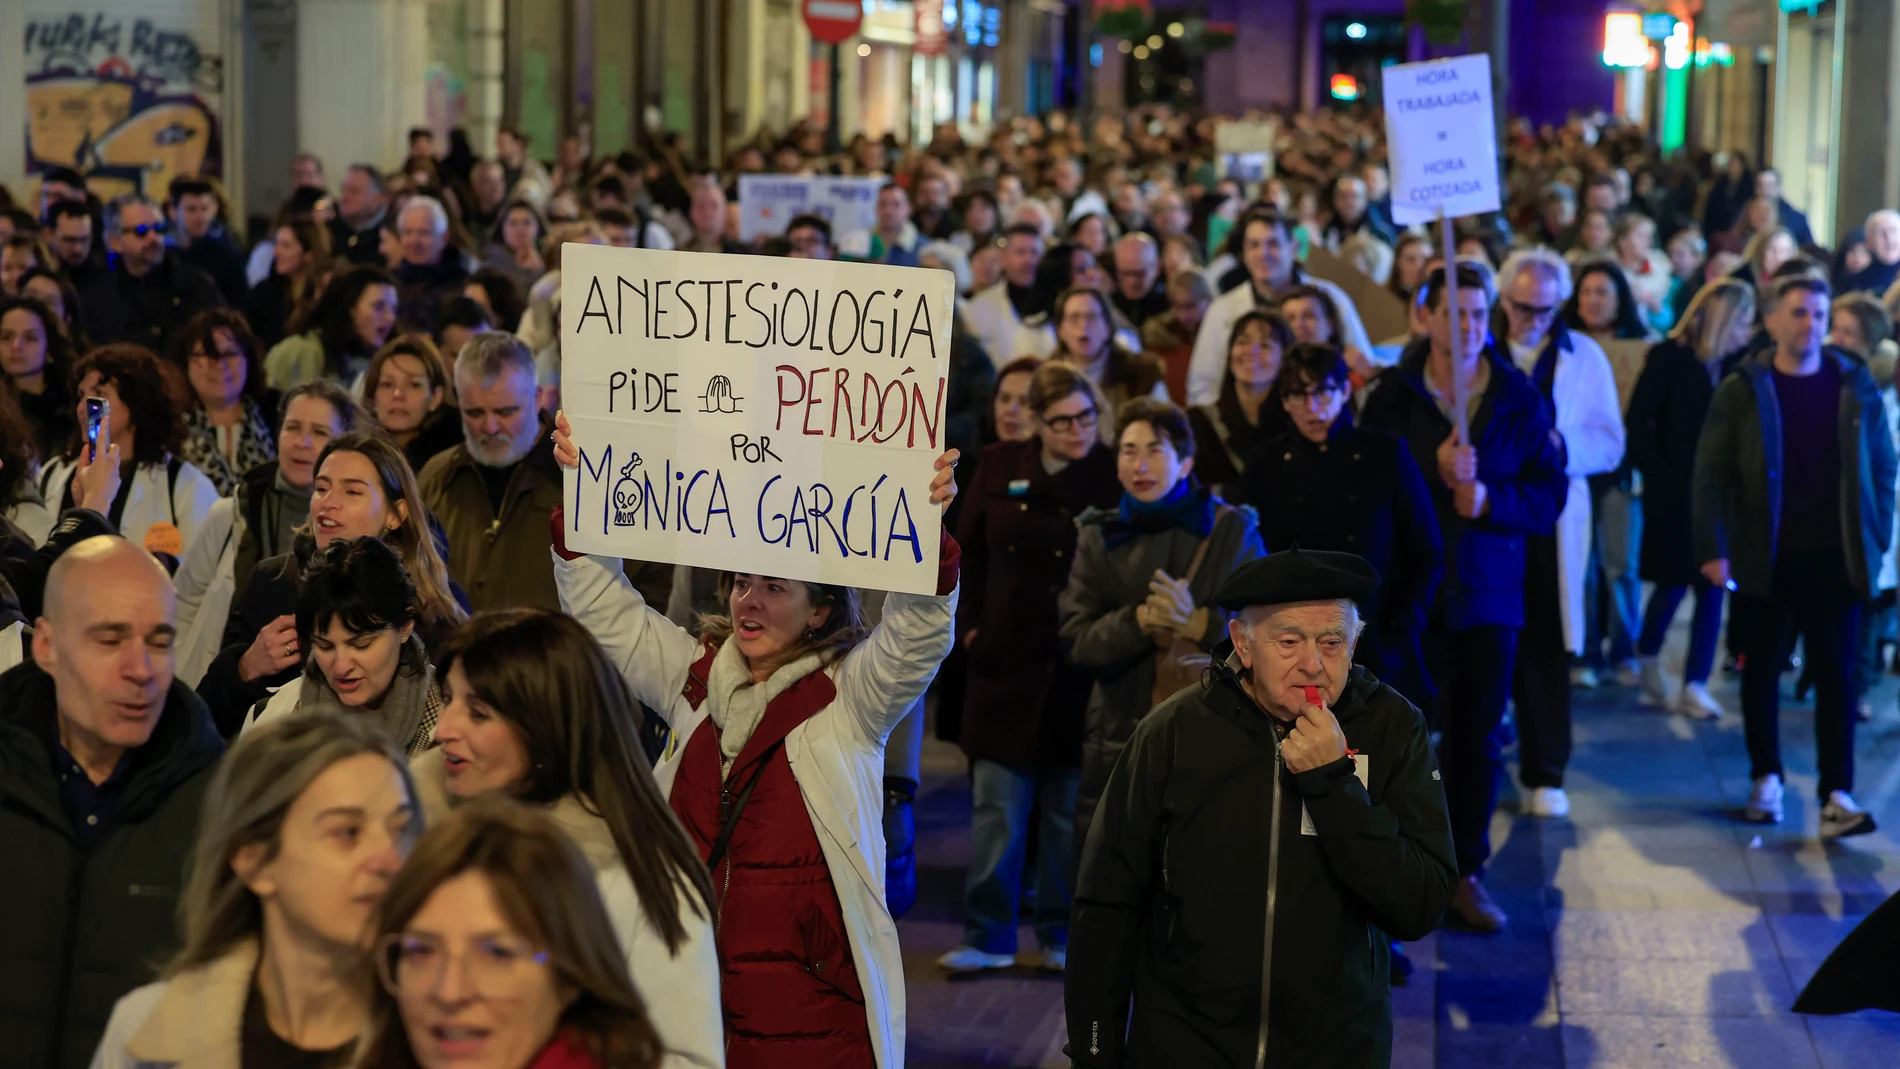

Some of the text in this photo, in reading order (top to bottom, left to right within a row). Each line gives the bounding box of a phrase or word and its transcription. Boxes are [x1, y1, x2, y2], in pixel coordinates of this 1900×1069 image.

[1415, 69, 1458, 85] HORA
[1397, 91, 1480, 112] TRABAJADA
[1423, 158, 1465, 174] HORA
[1410, 180, 1482, 202] COTIZADA
[775, 365, 945, 449] PERDÓN
[730, 433, 783, 463] POR
[757, 474, 923, 564] GARCÍA
